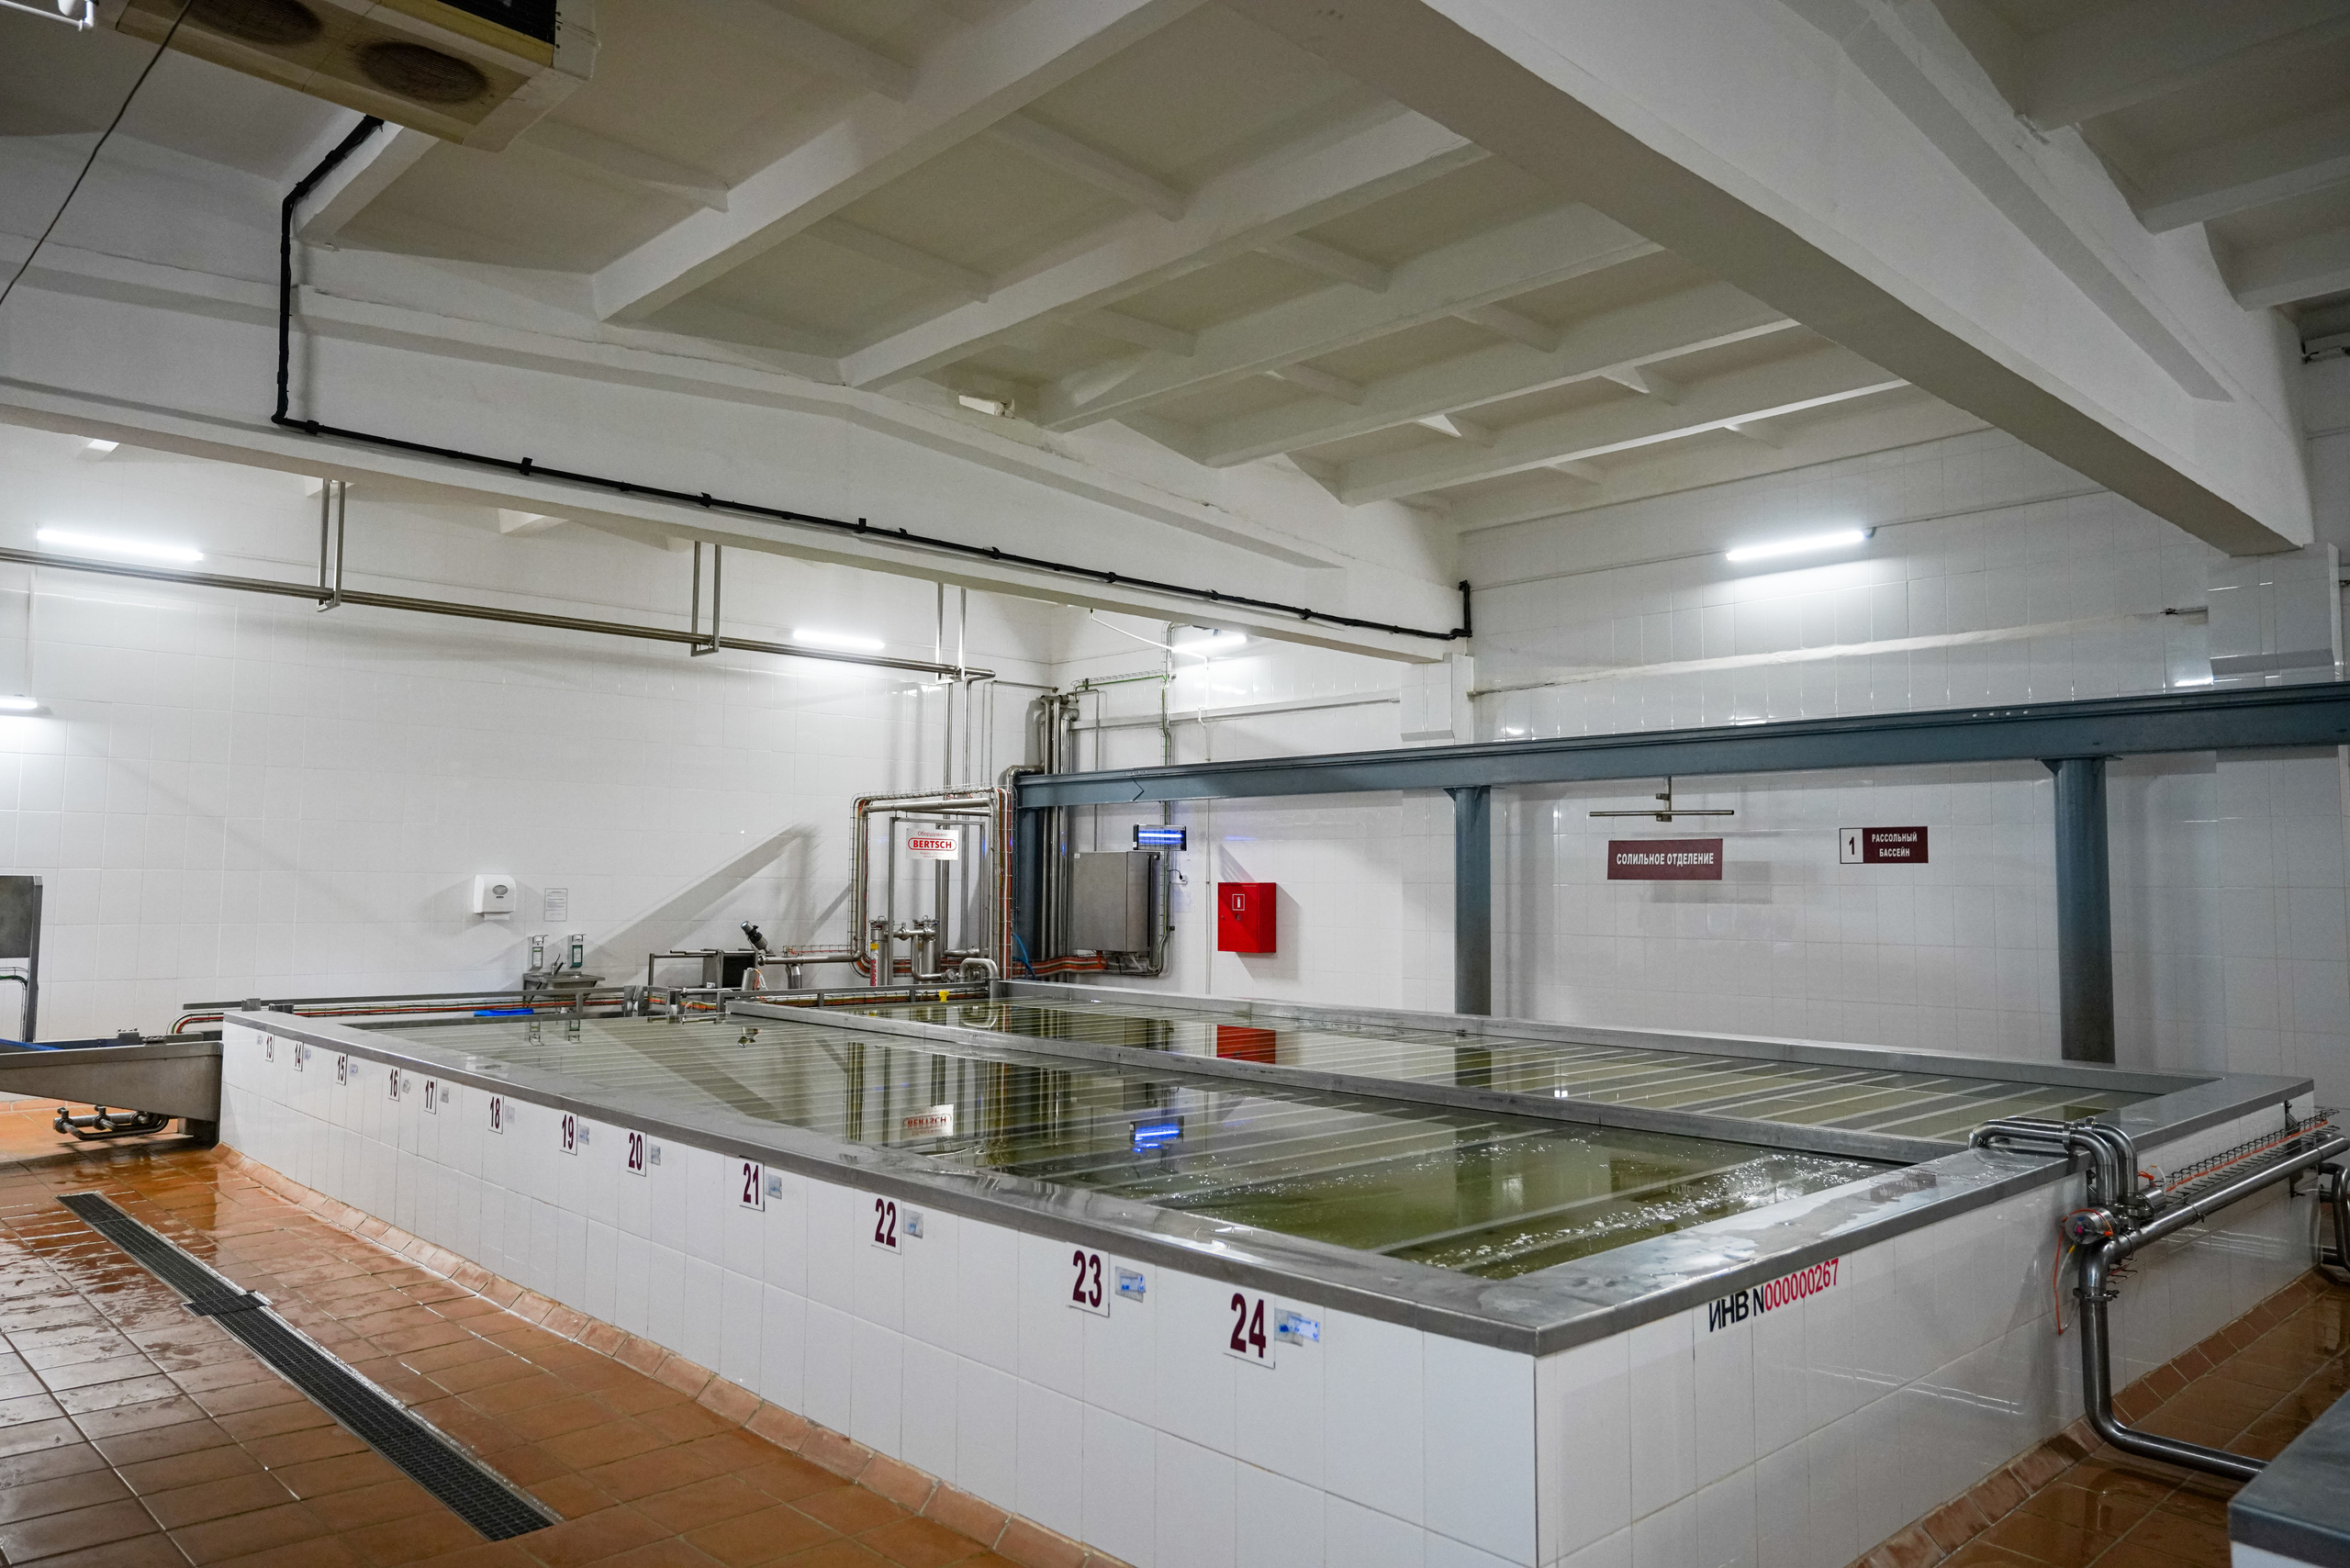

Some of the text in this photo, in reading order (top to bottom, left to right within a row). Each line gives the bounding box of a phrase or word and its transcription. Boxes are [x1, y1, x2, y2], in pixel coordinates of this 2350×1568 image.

[912, 839, 952, 849] BERTSCH
[1849, 836, 1855, 856] 1
[1872, 831, 1918, 843] РАССОЛЬНЫЙ
[1879, 846, 1910, 857] БАССЕЙН
[1617, 853, 1715, 867] СОЛИЛЬНОЕ ОТДЕЛЕНИЕ
[266, 1036, 273, 1058] 13
[295, 1043, 302, 1069] 14
[337, 1055, 345, 1082] 15
[389, 1068, 398, 1098] 16
[425, 1080, 434, 1110] 17
[489, 1096, 500, 1129] 18
[561, 1114, 575, 1150] 19
[628, 1132, 643, 1171] 20
[743, 1162, 759, 1205] 21
[874, 1197, 897, 1249] 22
[1072, 1249, 1102, 1308] 23
[1230, 1293, 1266, 1359] 24
[1708, 1290, 1749, 1333] ИНВ
